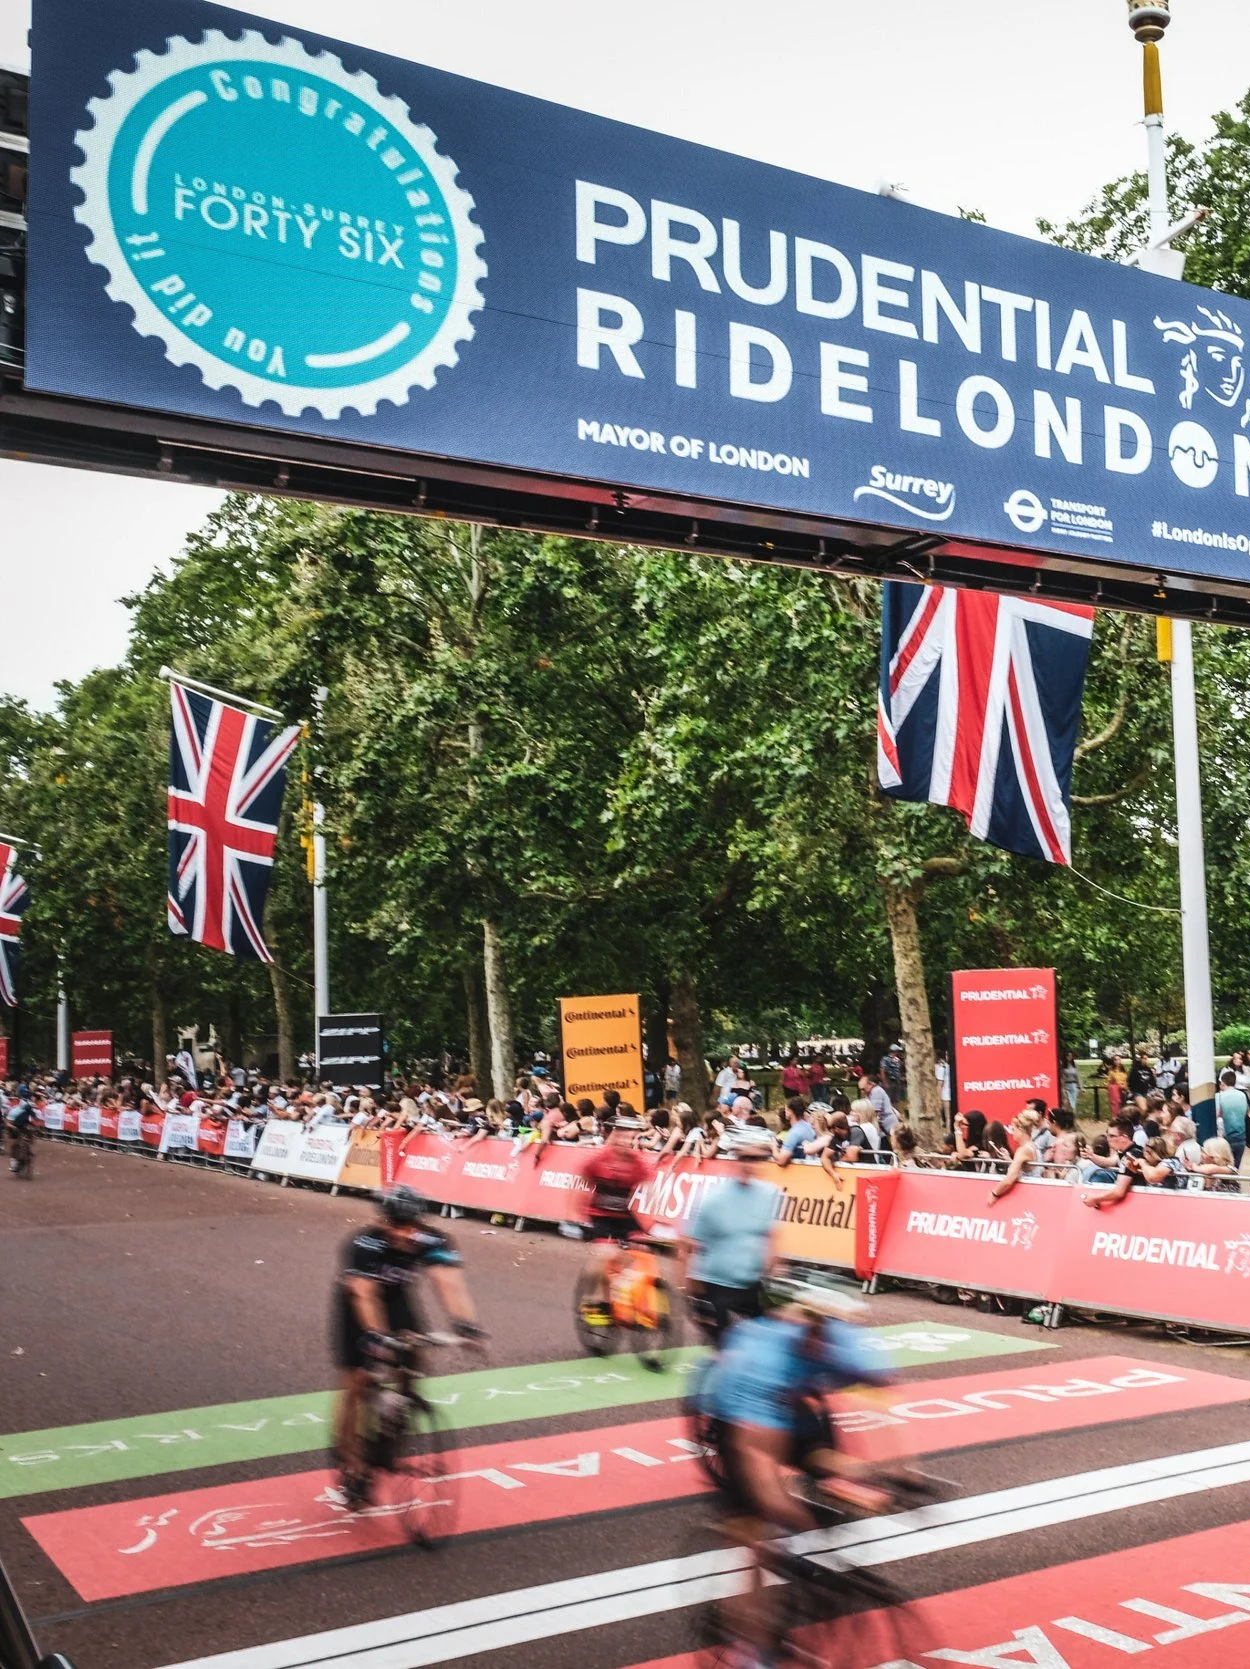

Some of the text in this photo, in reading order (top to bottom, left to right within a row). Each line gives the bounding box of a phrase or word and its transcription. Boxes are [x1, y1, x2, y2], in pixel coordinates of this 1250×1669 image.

[209, 68, 449, 314] Congratulations
[173, 186, 405, 269] FORTY SIX
[125, 231, 288, 378] You did it
[575, 179, 1155, 395] PRUDENTIAL
[577, 418, 811, 479] MAYOR OF LONDON
[869, 464, 955, 504] Surrey
[1050, 497, 1107, 518] TRANSPORT
[1050, 509, 1114, 532] FOR LONDON
[960, 989, 1031, 1001] PRUDENTIAL
[564, 1008, 626, 1024] Continental
[566, 1044, 629, 1060] Continental
[962, 1034, 1033, 1046] PRUDENTIAL
[963, 1078, 1035, 1092] PRUDENTIAL
[907, 1209, 1008, 1245] PRUDENTIAL
[1090, 1230, 1220, 1271] PRUDENTIAL
